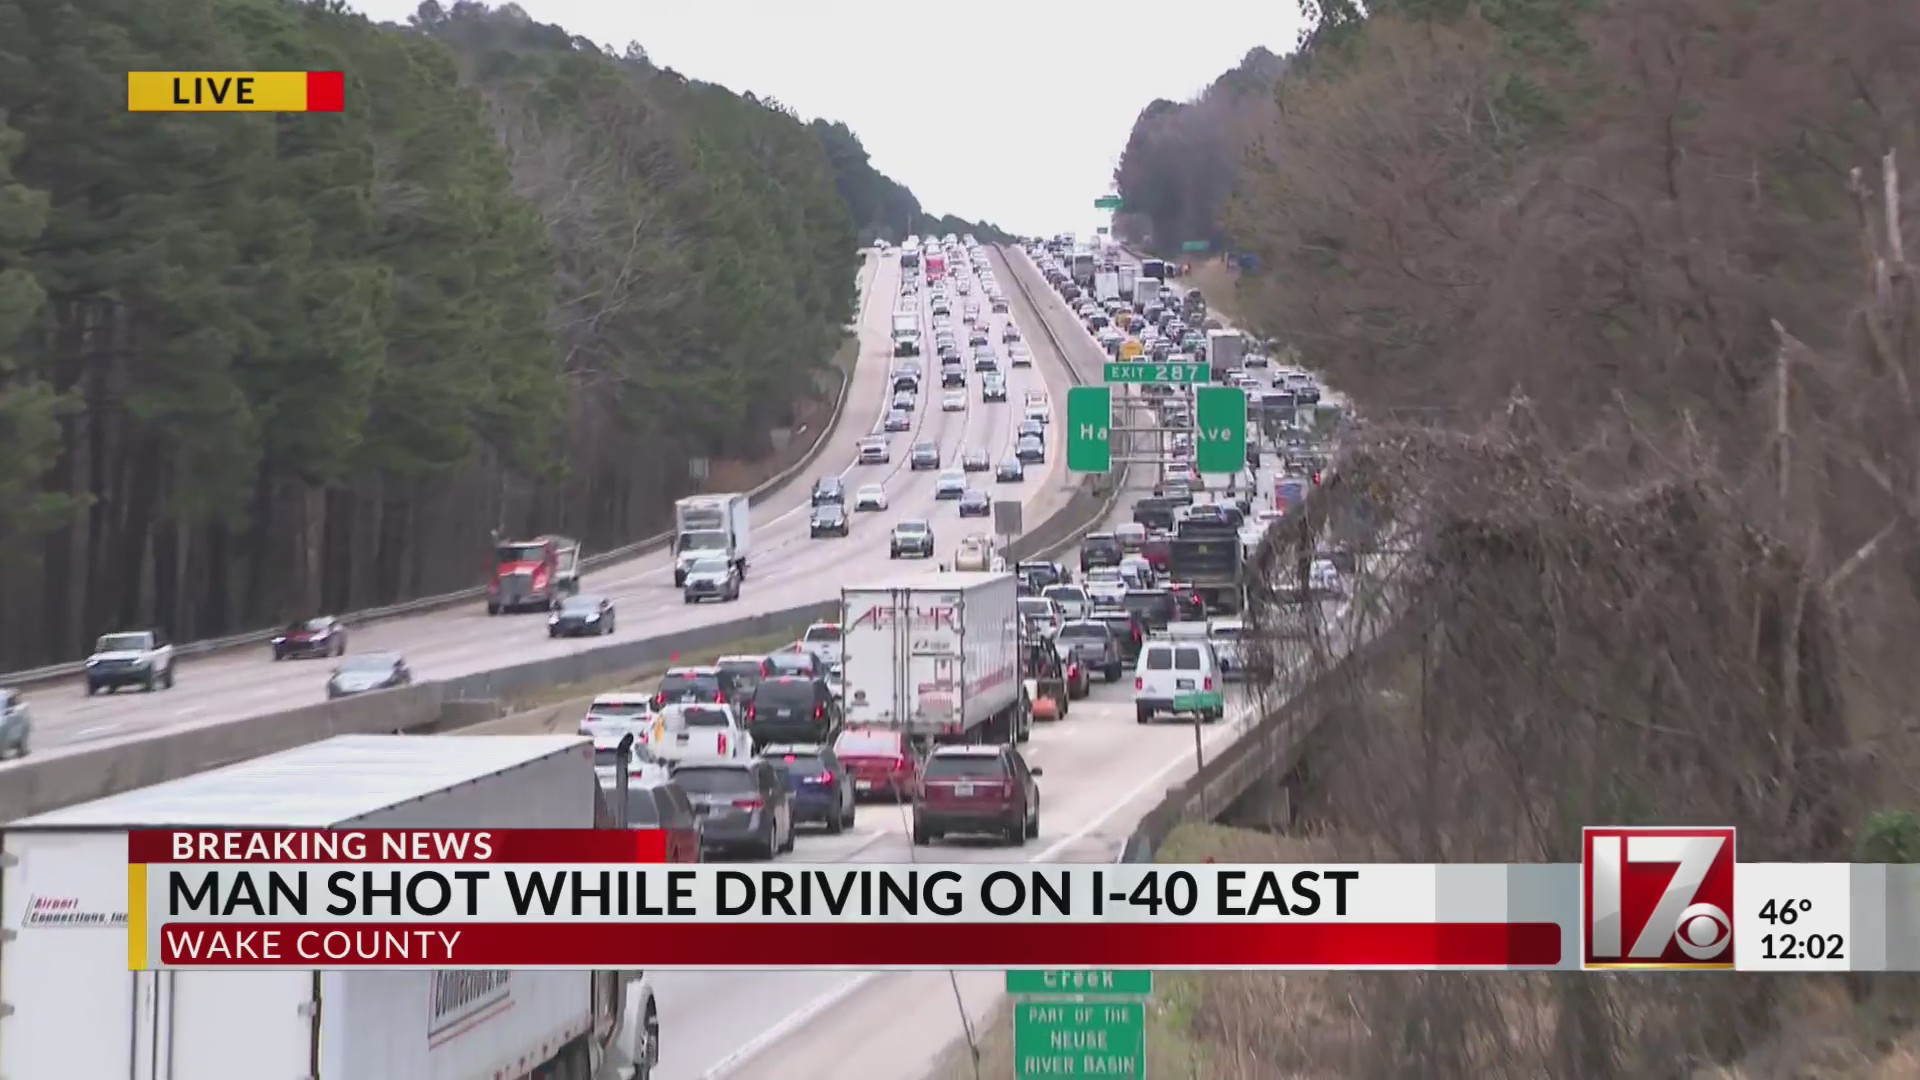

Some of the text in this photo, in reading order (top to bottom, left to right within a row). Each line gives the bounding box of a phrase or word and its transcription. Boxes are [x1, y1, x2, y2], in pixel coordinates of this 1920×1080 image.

[1111, 365, 1198, 381] EXIT 287
[1080, 423, 1107, 441] Ha
[34, 897, 79, 910] Airport
[1029, 1007, 1130, 1024] PART OF THE
[1050, 1030, 1108, 1051] NEUSE
[1025, 1055, 1136, 1074] RIVER BASIN
